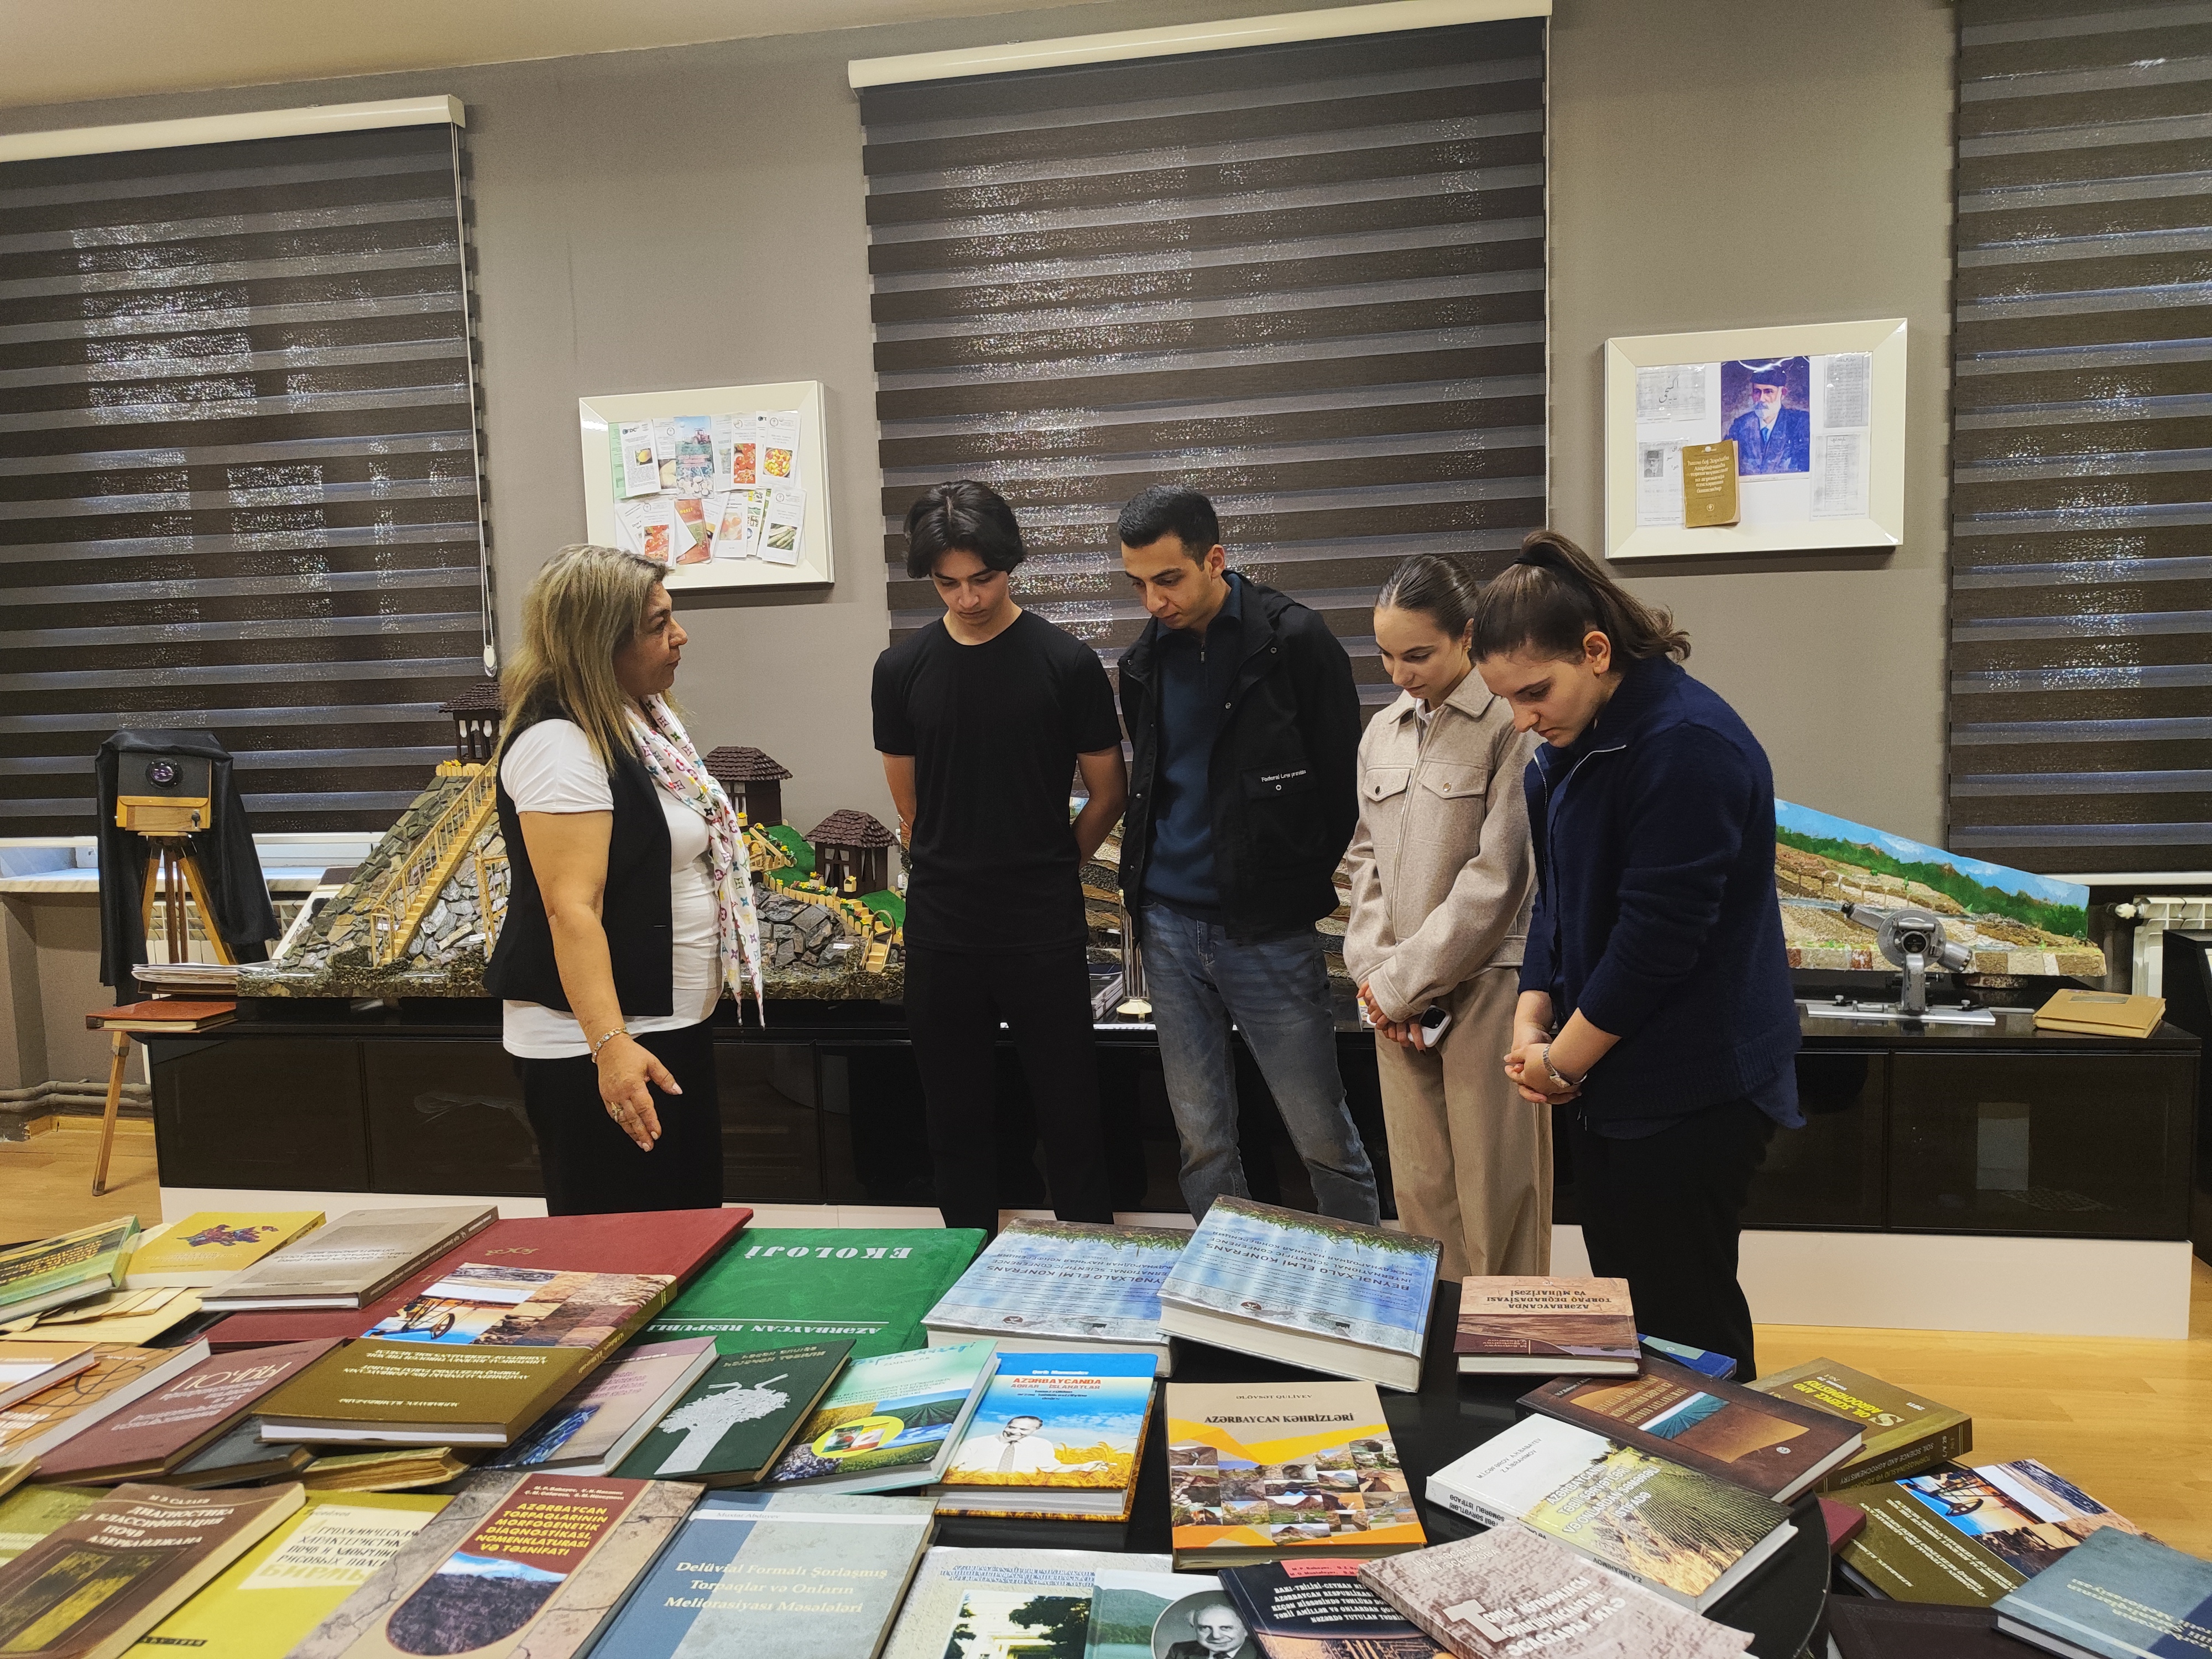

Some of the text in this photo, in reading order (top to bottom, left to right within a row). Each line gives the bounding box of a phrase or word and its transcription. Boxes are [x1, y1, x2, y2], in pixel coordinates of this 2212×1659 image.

[744, 1246, 915, 1259] EKOLOJİ
[1206, 1243, 1278, 1264] KONFRANS
[1282, 1246, 1325, 1258] НАУЧНАЯ
[992, 1259, 1052, 1268] CONFERENCE
[1209, 1237, 1411, 1284] INTERNATIONAL SCIENTIFIC CONFERENCE
[1281, 1260, 1315, 1271] ELMİ
[1328, 1256, 1412, 1277] МЕЖДУНАРОДНАЯ
[986, 1265, 1055, 1276] KONFRANS
[1094, 1274, 1165, 1284] YNƏLXALQ
[750, 1325, 883, 1334] AZƏRBAYCAN
[170, 1361, 293, 1392] ПОЧВЫ
[1793, 1383, 1817, 1394] AND
[1803, 1380, 1884, 1413] AGROCHEMISTRY
[1813, 1392, 1854, 1410] SCIENCE
[1283, 1412, 1354, 1422] KƏHRİZLƏRİ
[1840, 1442, 1934, 1485] SOIL SCIENCE AND AGROCHEMISTRY
[1547, 1463, 1609, 1504] AZƏRBAYCANIN
[1579, 1465, 1631, 1500] SƏRVƏTLƏRİ
[127, 1506, 235, 1519] ДИАГНОСТИКА
[517, 1503, 608, 1515] AZƏRBAYCAN
[1449, 1503, 1484, 1521] SƏRVƏTLƏRİ
[1563, 1521, 1582, 1534] VƏ
[1579, 1495, 1621, 1525] ONLARDAN
[503, 1510, 609, 1523] TORPAQLARININ
[102, 1525, 145, 1537] ПОЧВ
[494, 1519, 601, 1531] MORFOGENETİK
[86, 1535, 202, 1547] АЗЕРБАЙДЖАНА
[475, 1535, 590, 1548] NOMENKLATURASI
[502, 1544, 571, 1556] TƏSNİFATI
[276, 1554, 343, 1566] РИСОВЫХ
[675, 1561, 889, 1579] Delüvial Formalı Şorlaşmış
[690, 1580, 767, 1594] Torpaqlar
[792, 1584, 854, 1594] Onların
[1274, 1592, 1322, 1603] AZƏRBAYCAN
[664, 1597, 864, 1614] Meliorasiyası Məsələləri
[1271, 1602, 1296, 1611] KEÇƏN
[1274, 1609, 1295, 1620] TƏBİİ
[1296, 1606, 1329, 1616] AMİLLƏR
[1310, 1615, 1343, 1623] NƏZƏRDƏ
